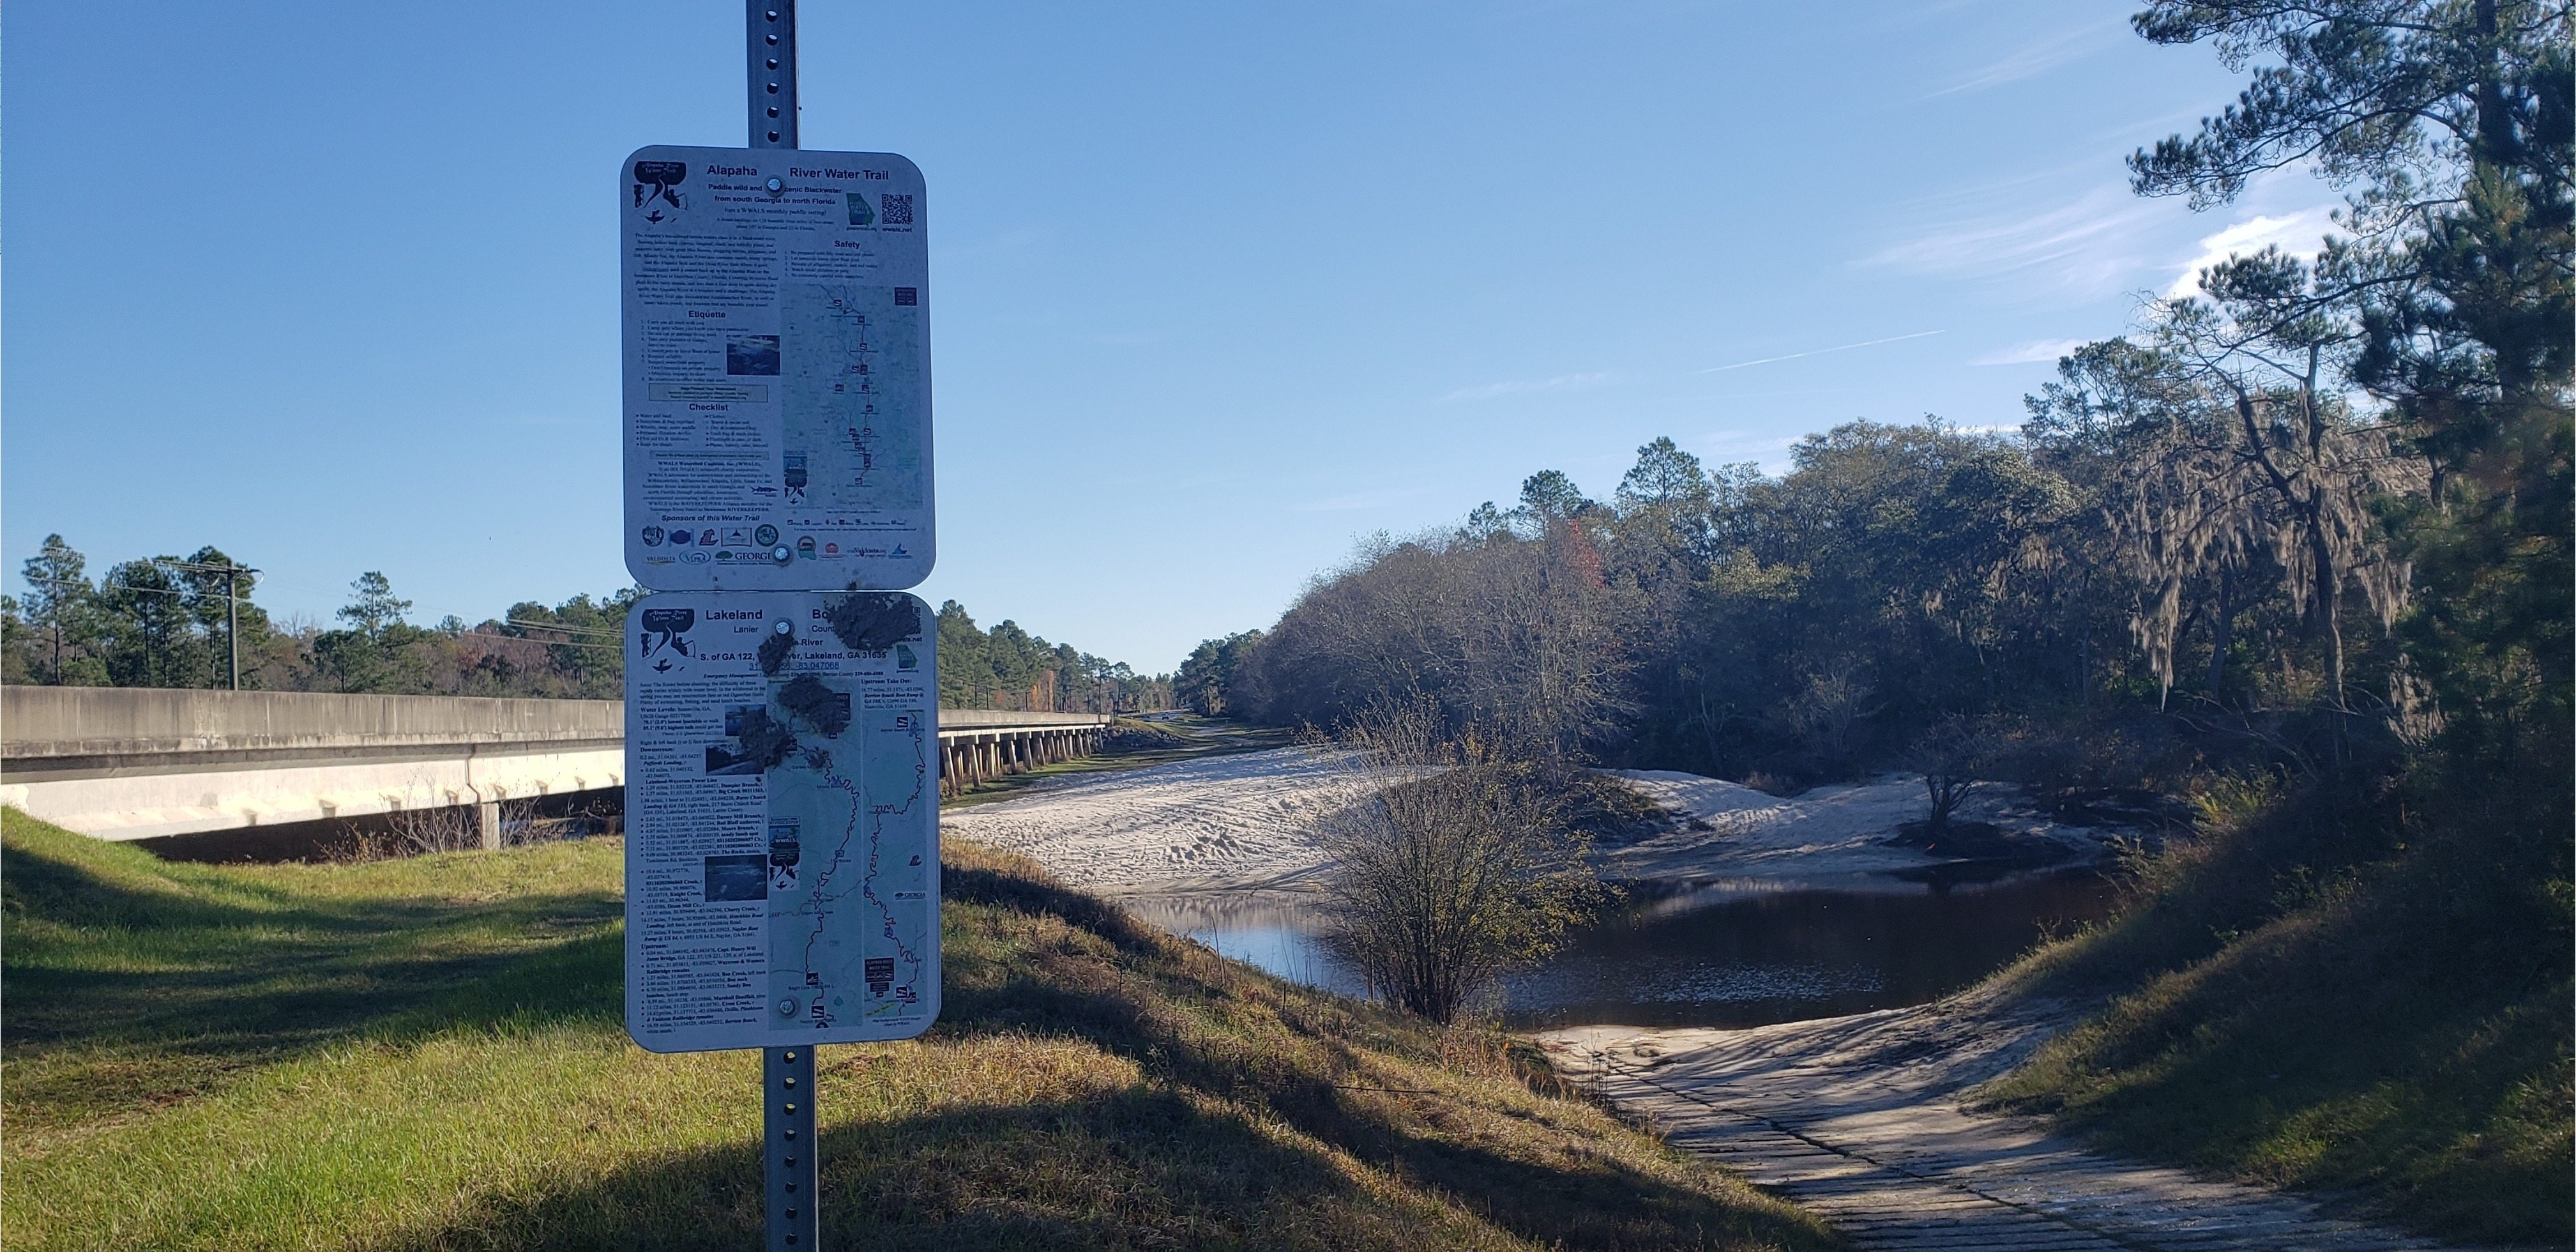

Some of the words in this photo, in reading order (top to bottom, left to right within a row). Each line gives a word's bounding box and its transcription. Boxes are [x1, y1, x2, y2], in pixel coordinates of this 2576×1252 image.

[707, 165, 757, 176] Alapaha
[790, 168, 821, 178] River
[824, 169, 860, 179] Water
[863, 170, 889, 179] Trail
[835, 241, 860, 249] Safety
[689, 310, 725, 319] Etiquette
[706, 609, 762, 620] Lakeland
